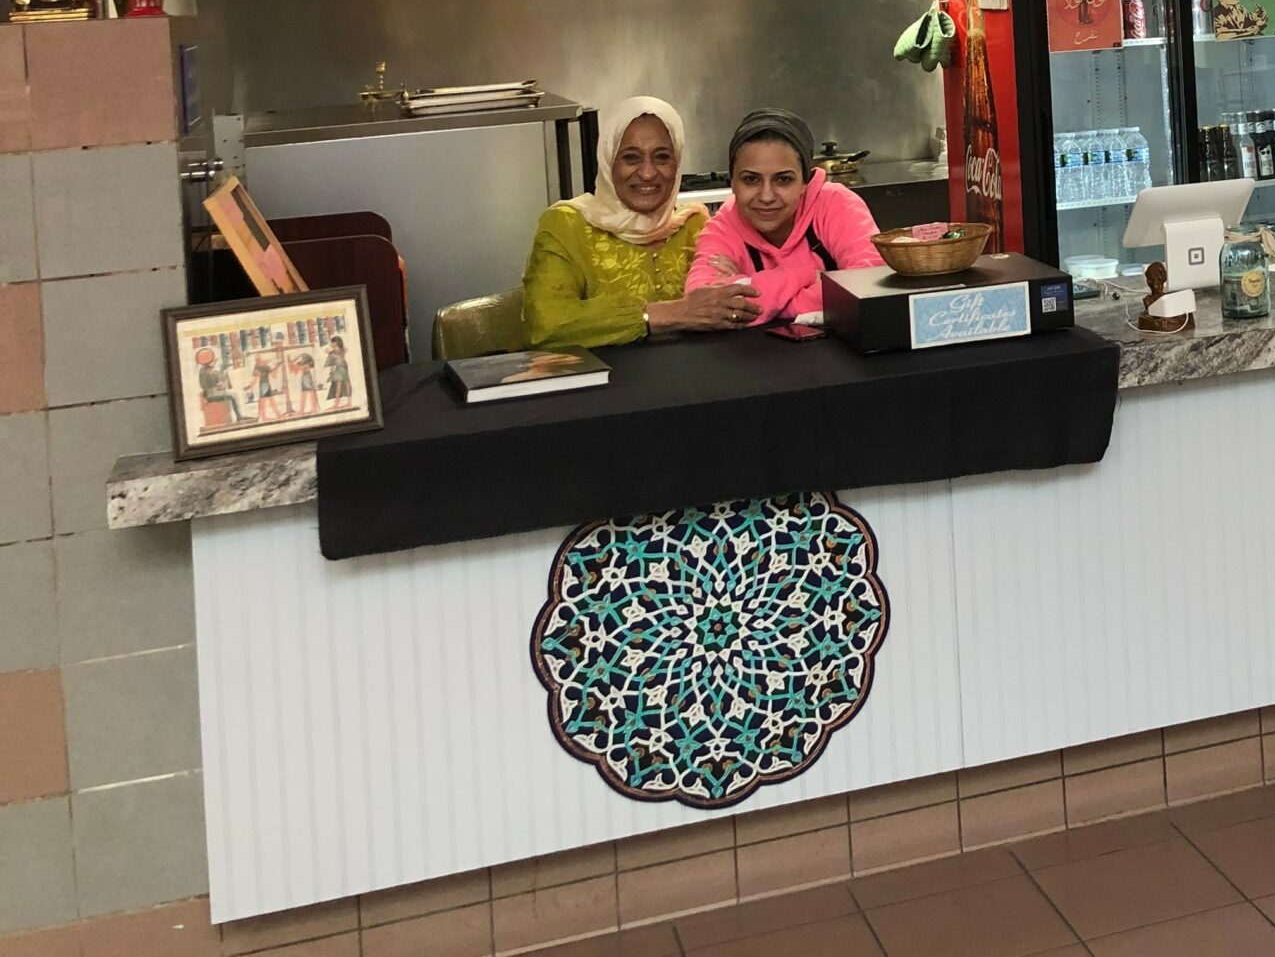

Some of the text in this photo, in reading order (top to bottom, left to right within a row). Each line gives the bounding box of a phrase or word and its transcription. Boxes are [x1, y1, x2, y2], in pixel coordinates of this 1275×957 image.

[949, 293, 985, 312] Gift
[928, 306, 1016, 327] Certificates
[926, 318, 1011, 342] Available
